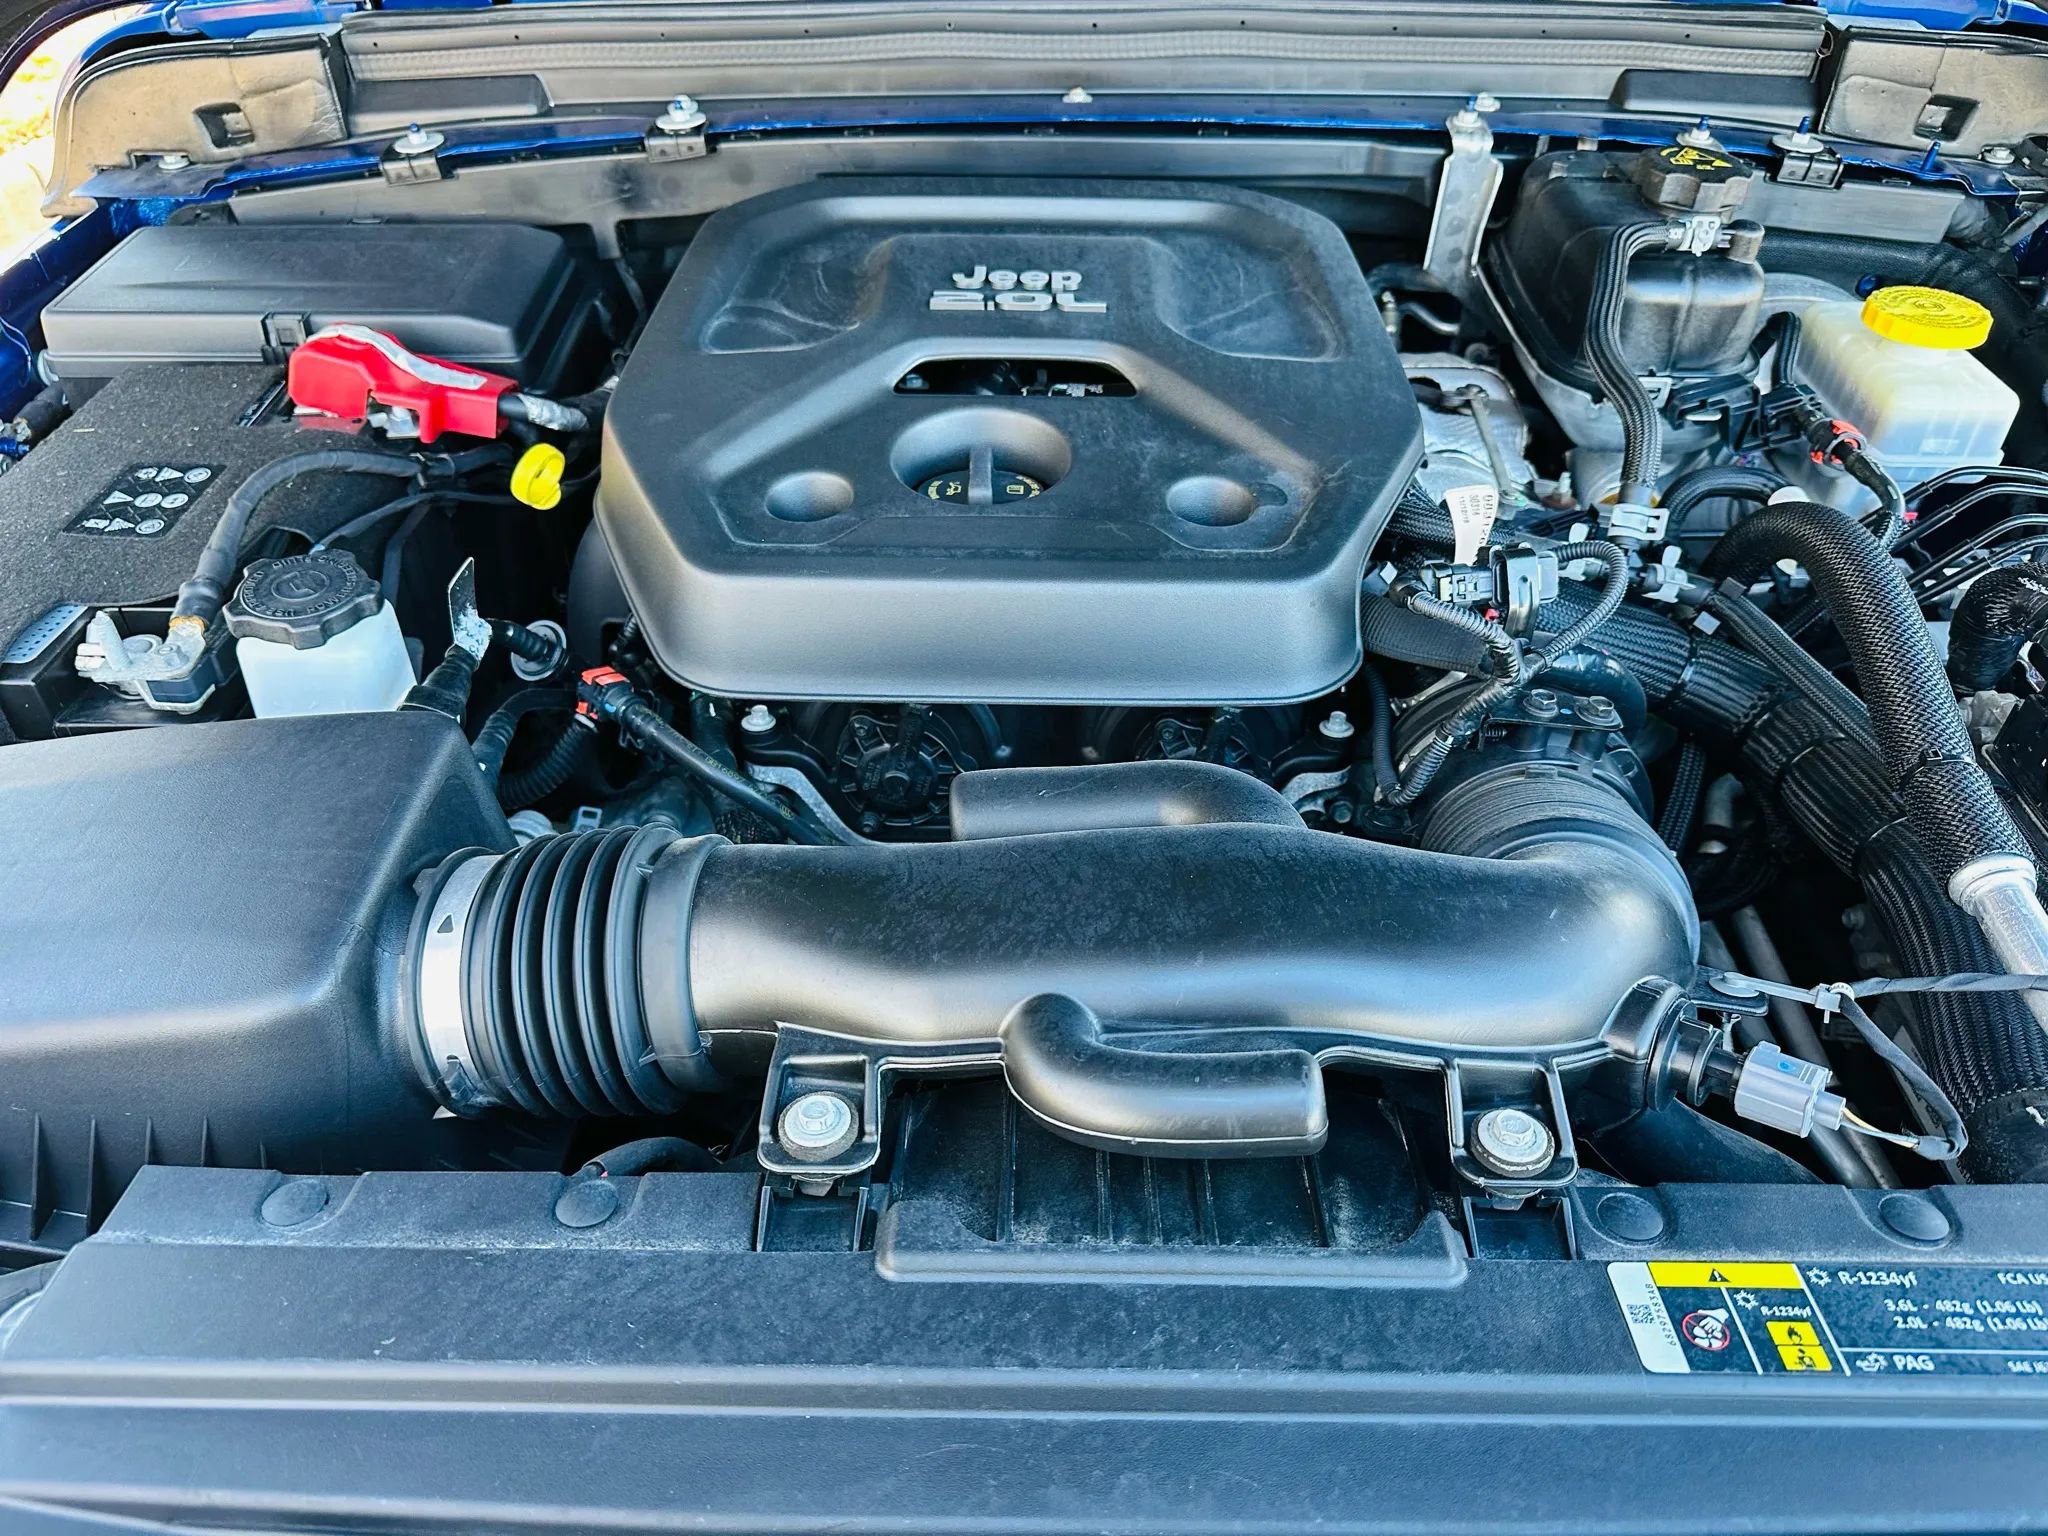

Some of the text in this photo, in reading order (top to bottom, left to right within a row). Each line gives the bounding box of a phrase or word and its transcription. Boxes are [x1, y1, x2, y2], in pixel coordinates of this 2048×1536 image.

[952, 265, 1082, 294] Jeep
[929, 291, 1107, 313] 2.0L
[1838, 1271, 1917, 1288] R-1234yf
[1997, 1273, 2029, 1285] FCA
[1760, 1305, 1812, 1318] R-1234yf
[1884, 1299, 1918, 1312] 3.6L
[1936, 1300, 1974, 1315] 482g
[1976, 1299, 2016, 1315] (1.06
[1893, 1316, 1928, 1329] 2.0L
[1946, 1316, 1985, 1332] 482g
[1986, 1316, 2028, 1332] (1.06
[1893, 1354, 1935, 1371] PAG
